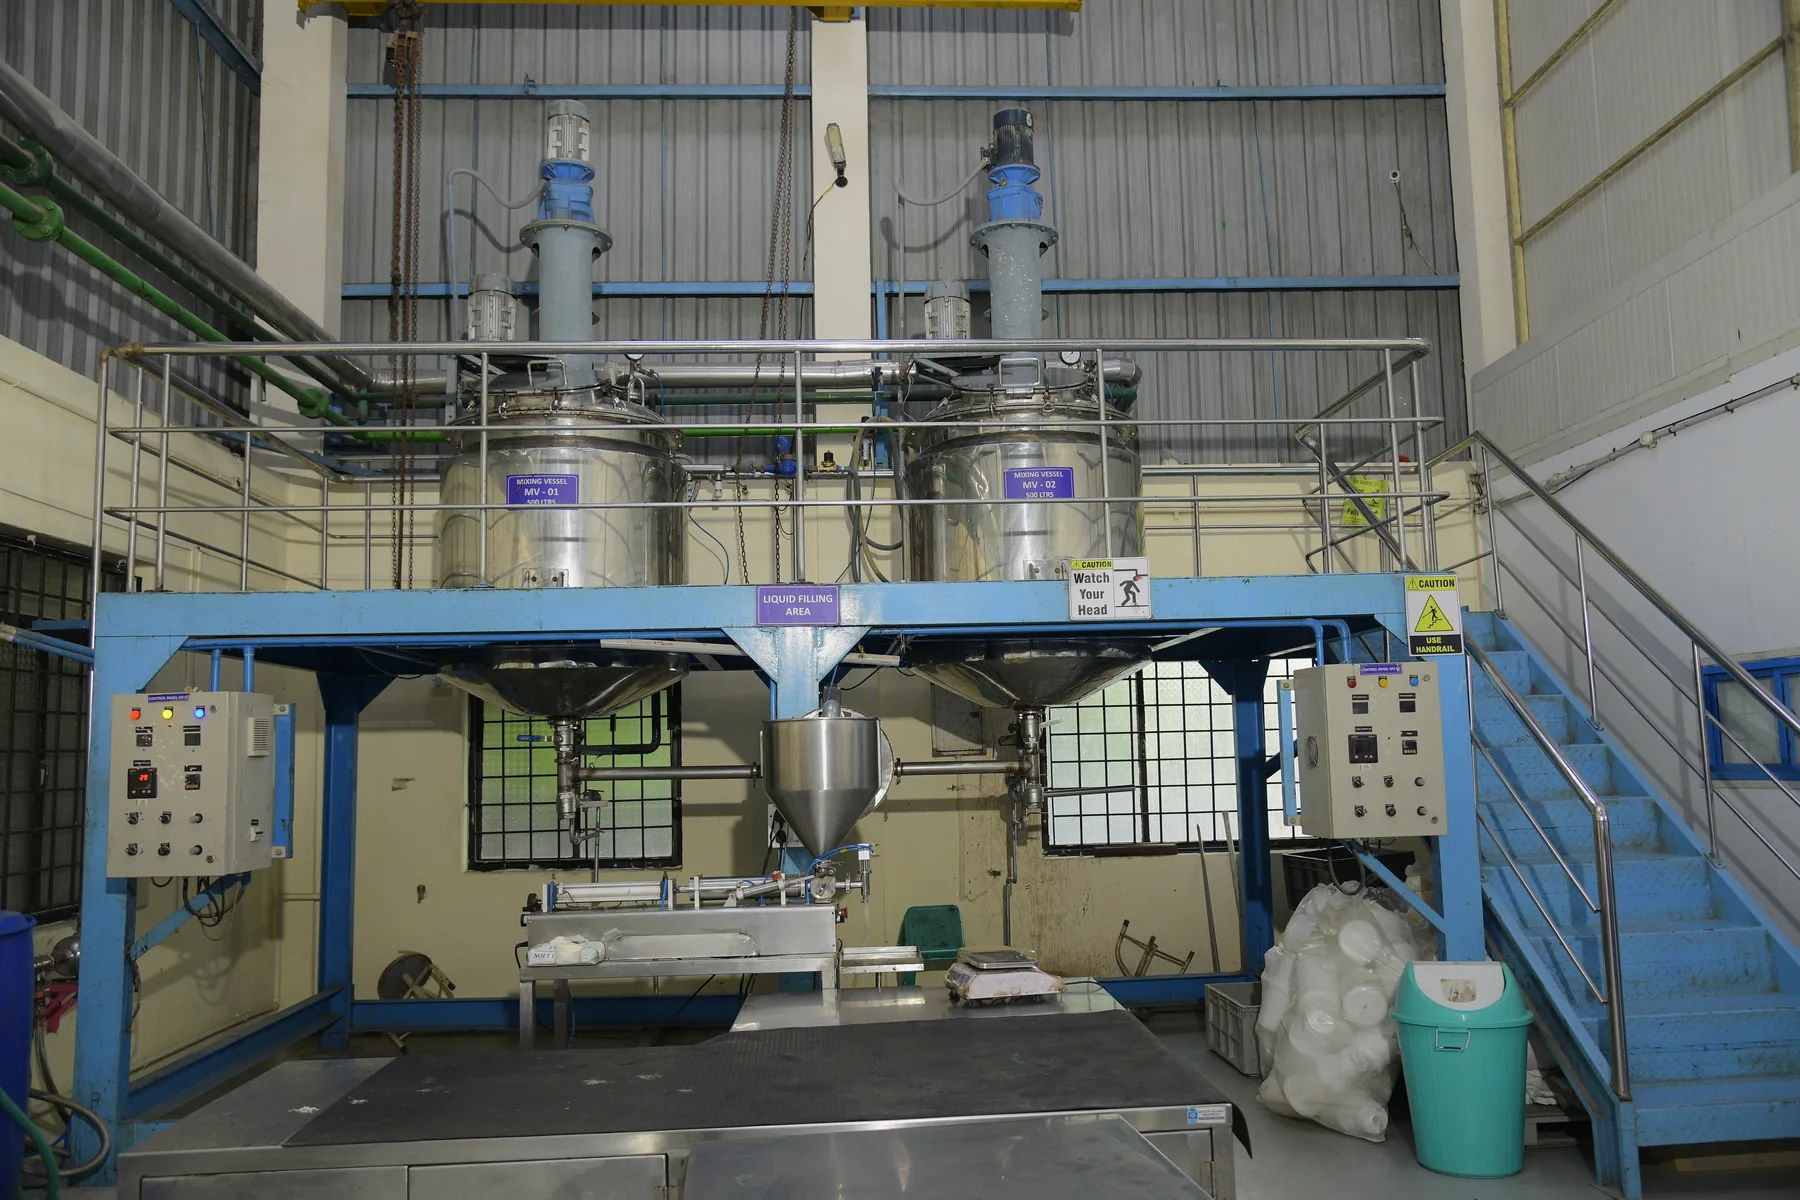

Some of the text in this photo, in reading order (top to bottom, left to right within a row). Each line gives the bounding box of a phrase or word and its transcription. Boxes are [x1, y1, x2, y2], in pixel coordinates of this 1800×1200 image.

[524, 488, 540, 496] MV
[1074, 572, 1110, 583] Watch
[1079, 589, 1104, 599] Your
[764, 595, 796, 604] LIQUID
[786, 608, 811, 616] AREA
[1078, 604, 1107, 615] Head
